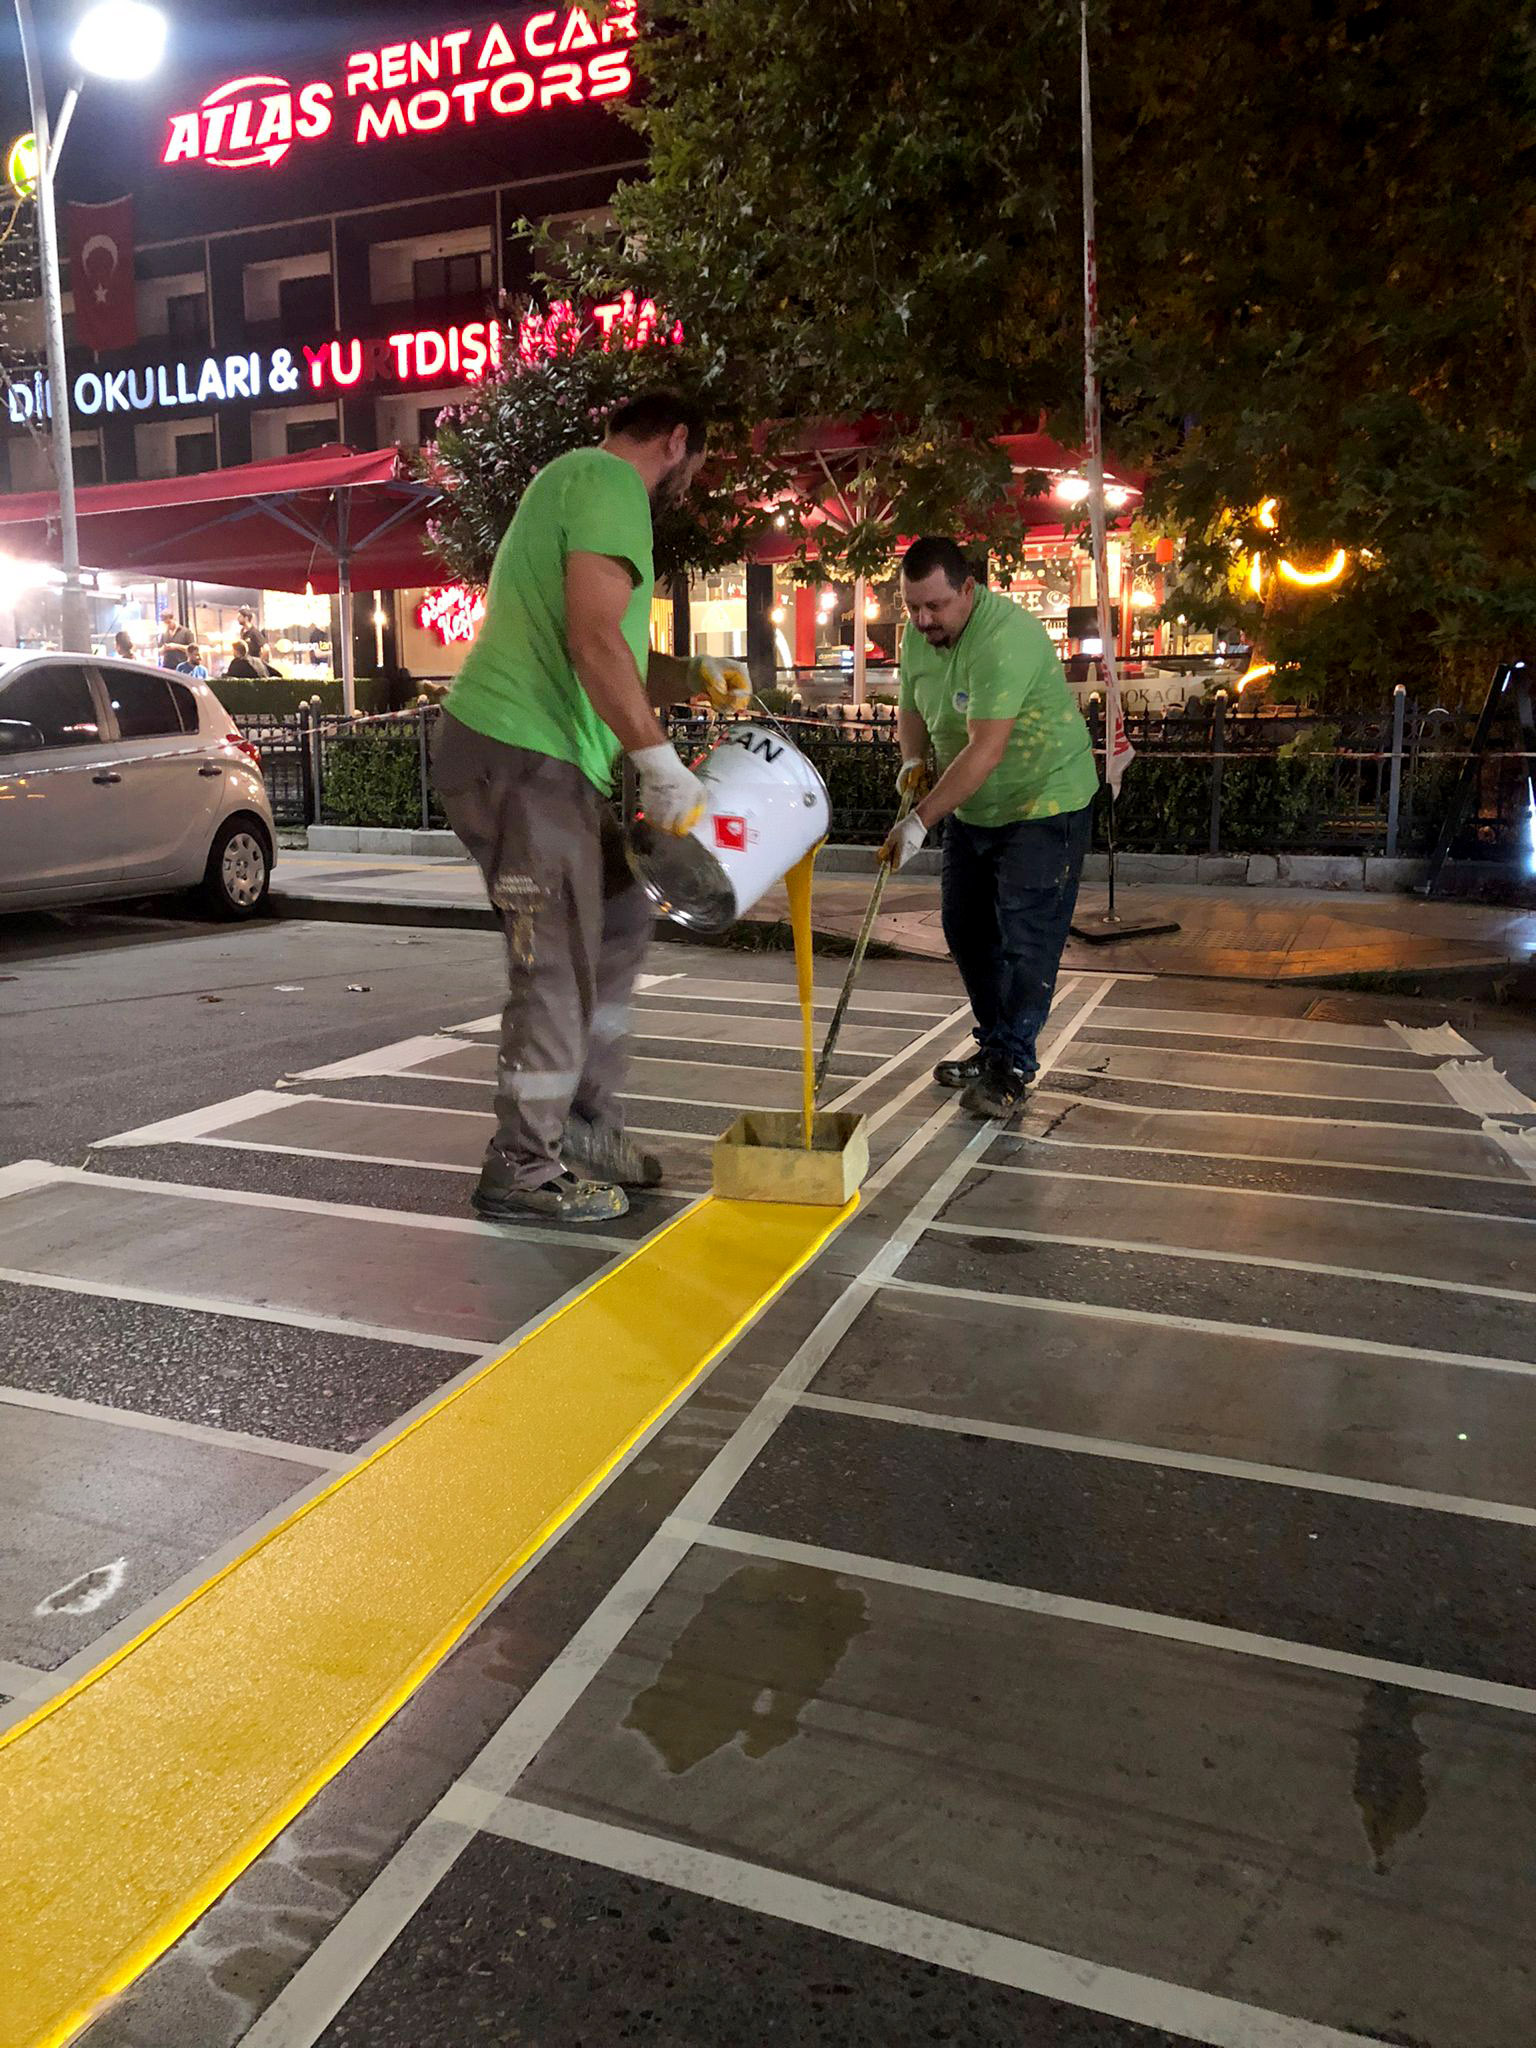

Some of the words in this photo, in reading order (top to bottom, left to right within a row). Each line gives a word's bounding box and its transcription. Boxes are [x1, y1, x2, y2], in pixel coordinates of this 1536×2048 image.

[346, 29, 473, 97] RENT
[476, 21, 517, 71] A
[523, 0, 639, 58] CAR
[163, 82, 334, 163] ATLAS
[355, 49, 633, 144] MOTORS
[73, 351, 262, 415] OKULLARI
[268, 347, 299, 393] &
[1120, 683, 1186, 704] OKAĞI
